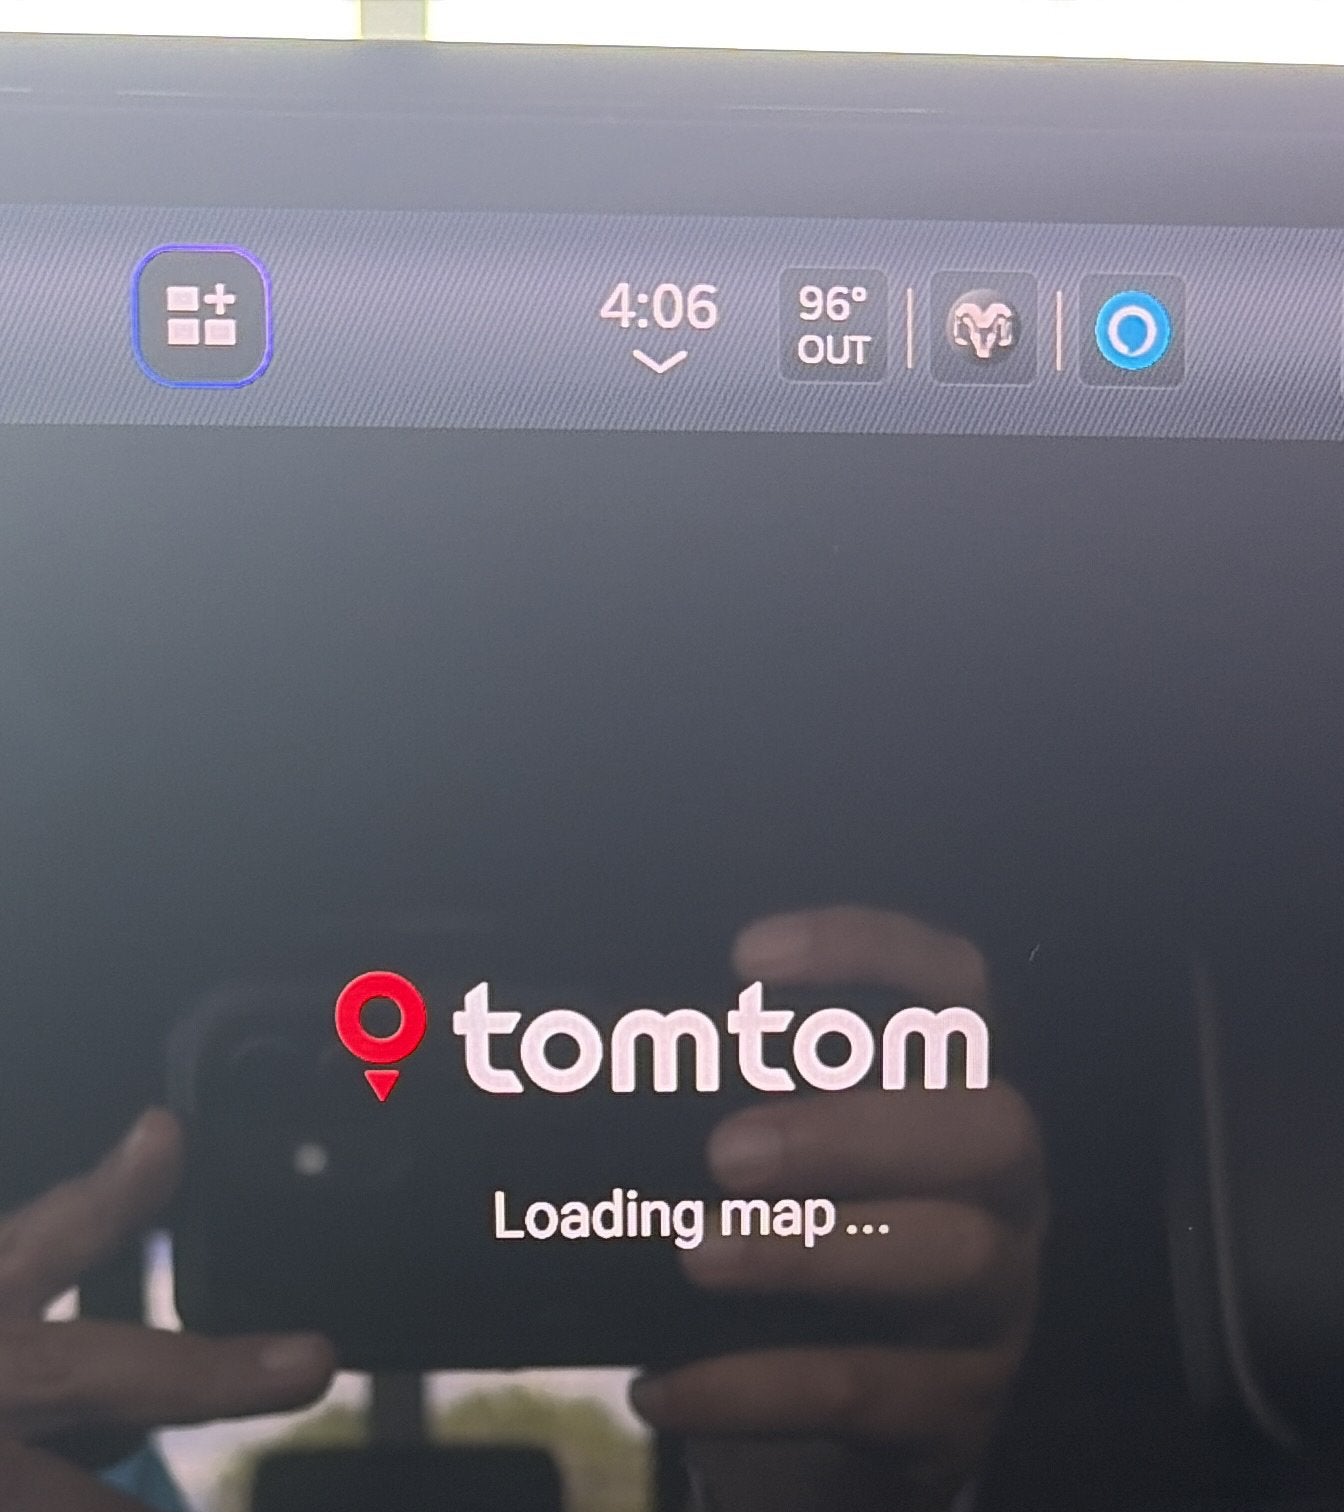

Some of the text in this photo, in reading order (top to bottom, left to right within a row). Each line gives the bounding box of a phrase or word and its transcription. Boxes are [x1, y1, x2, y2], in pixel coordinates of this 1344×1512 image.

[599, 281, 719, 330] 4:06
[797, 334, 872, 365] OUT
[452, 981, 990, 1094] tomtom
[494, 1188, 704, 1249] Loading
